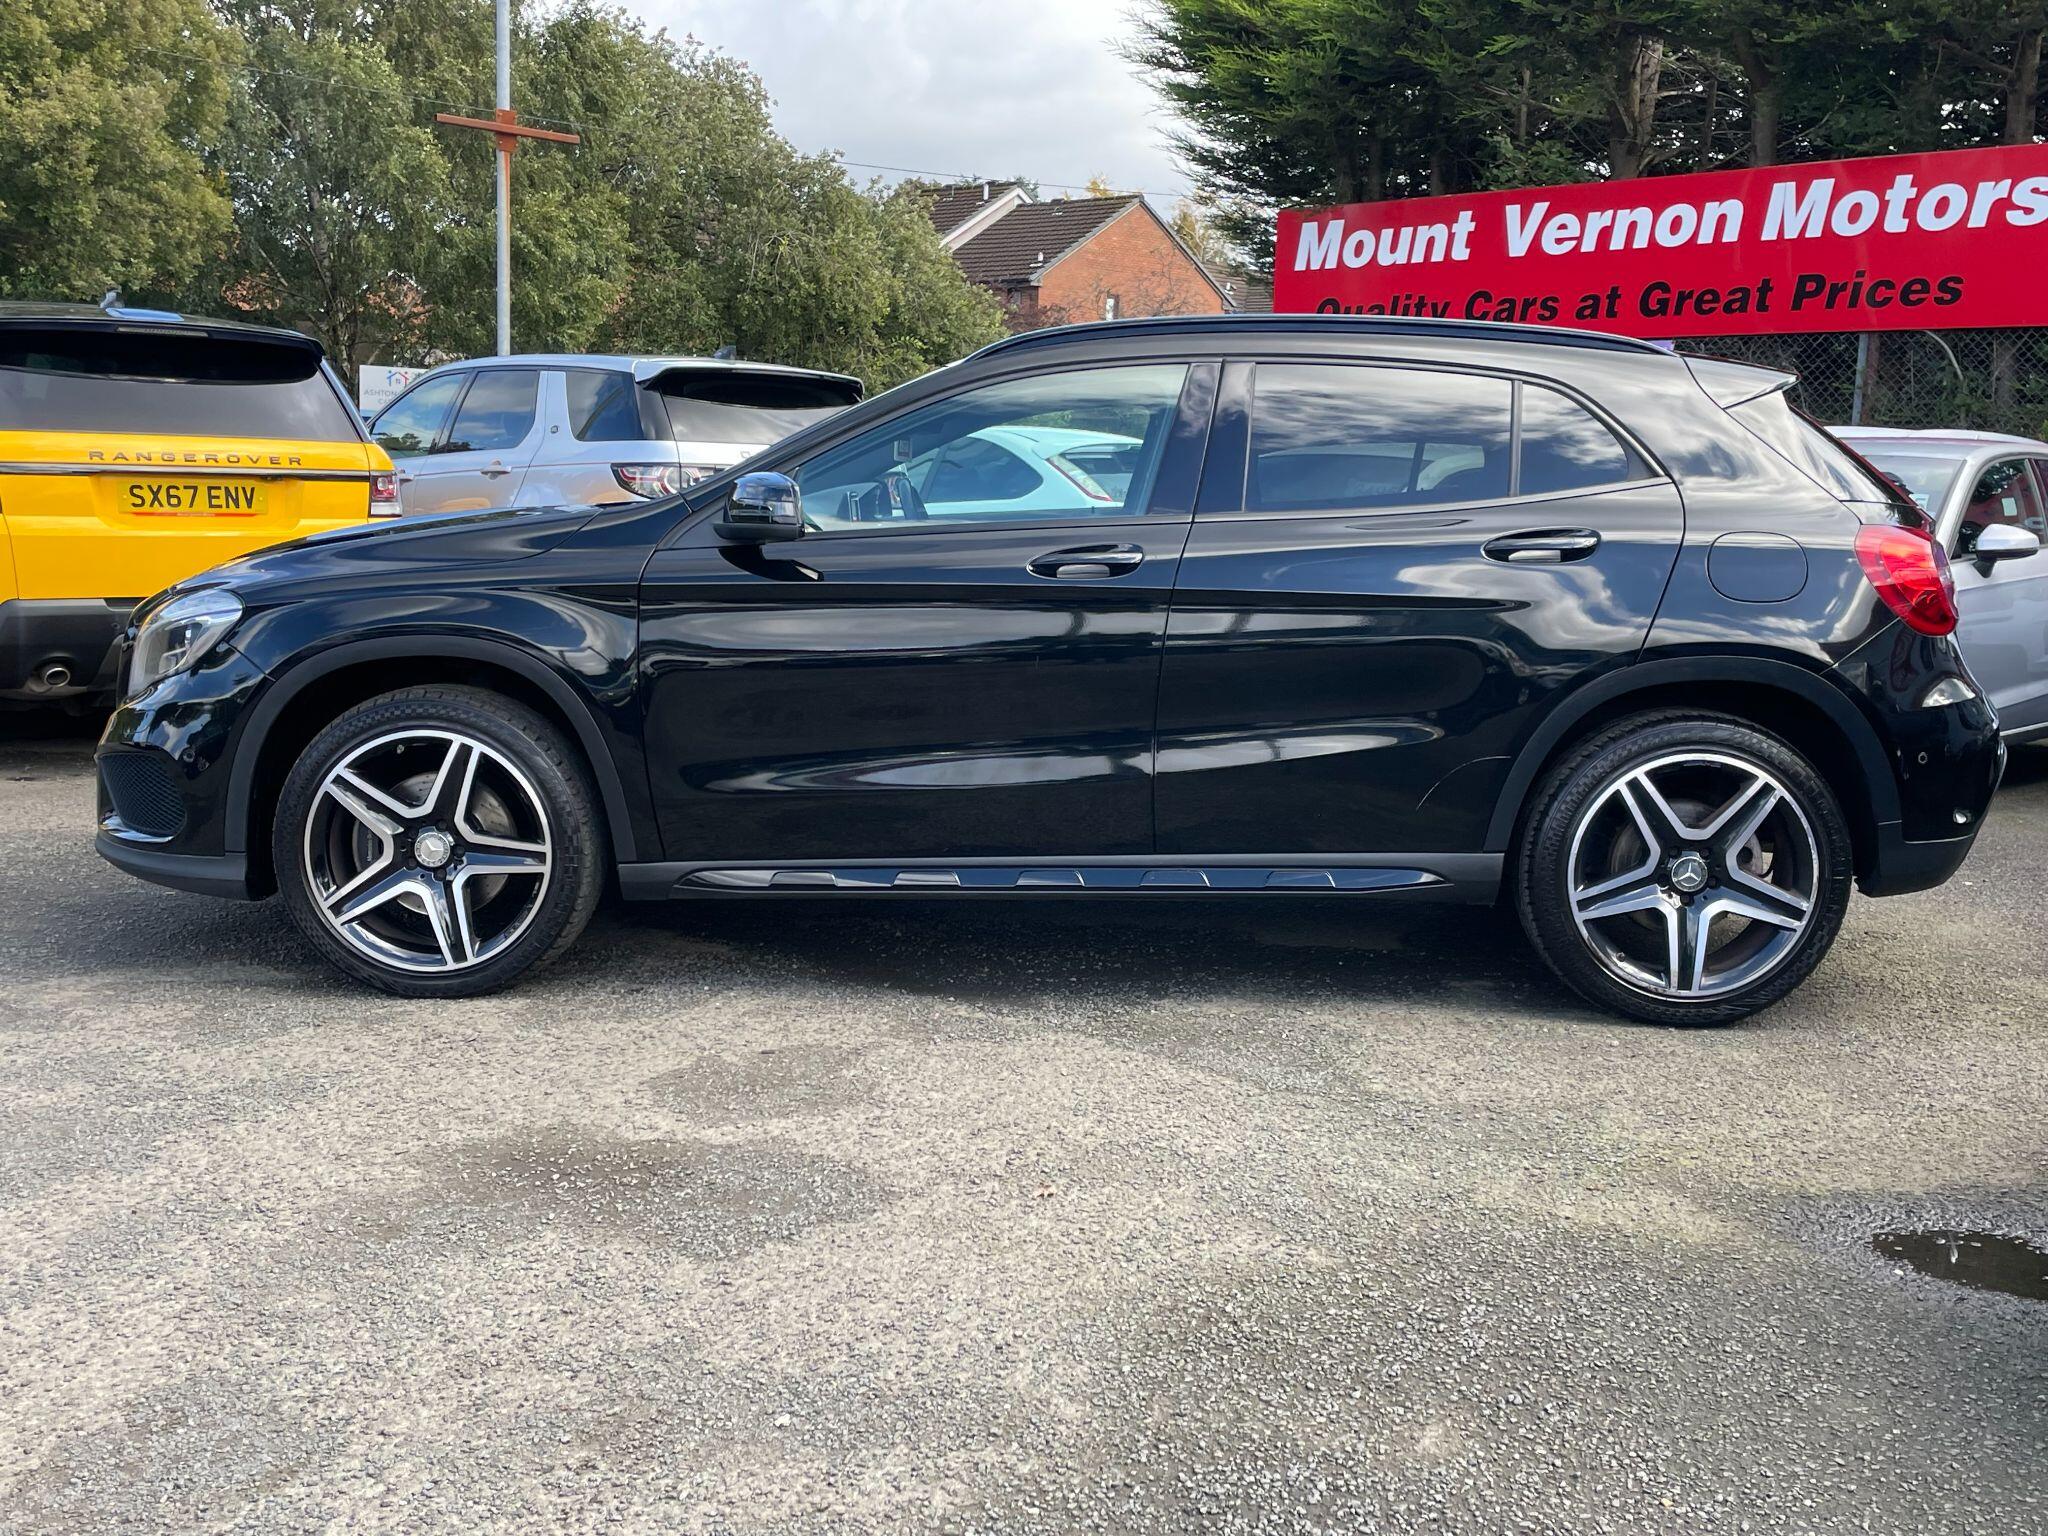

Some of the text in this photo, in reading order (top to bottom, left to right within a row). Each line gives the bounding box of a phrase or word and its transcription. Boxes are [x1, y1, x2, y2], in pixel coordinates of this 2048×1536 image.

[1294, 174, 2048, 272] Mount Vernon Motors
[1465, 290, 1560, 322] Cars
[1575, 285, 1622, 320] at
[1639, 276, 1774, 318] Great
[1790, 270, 1964, 312] Prices
[128, 484, 256, 509] SX67 ENV
